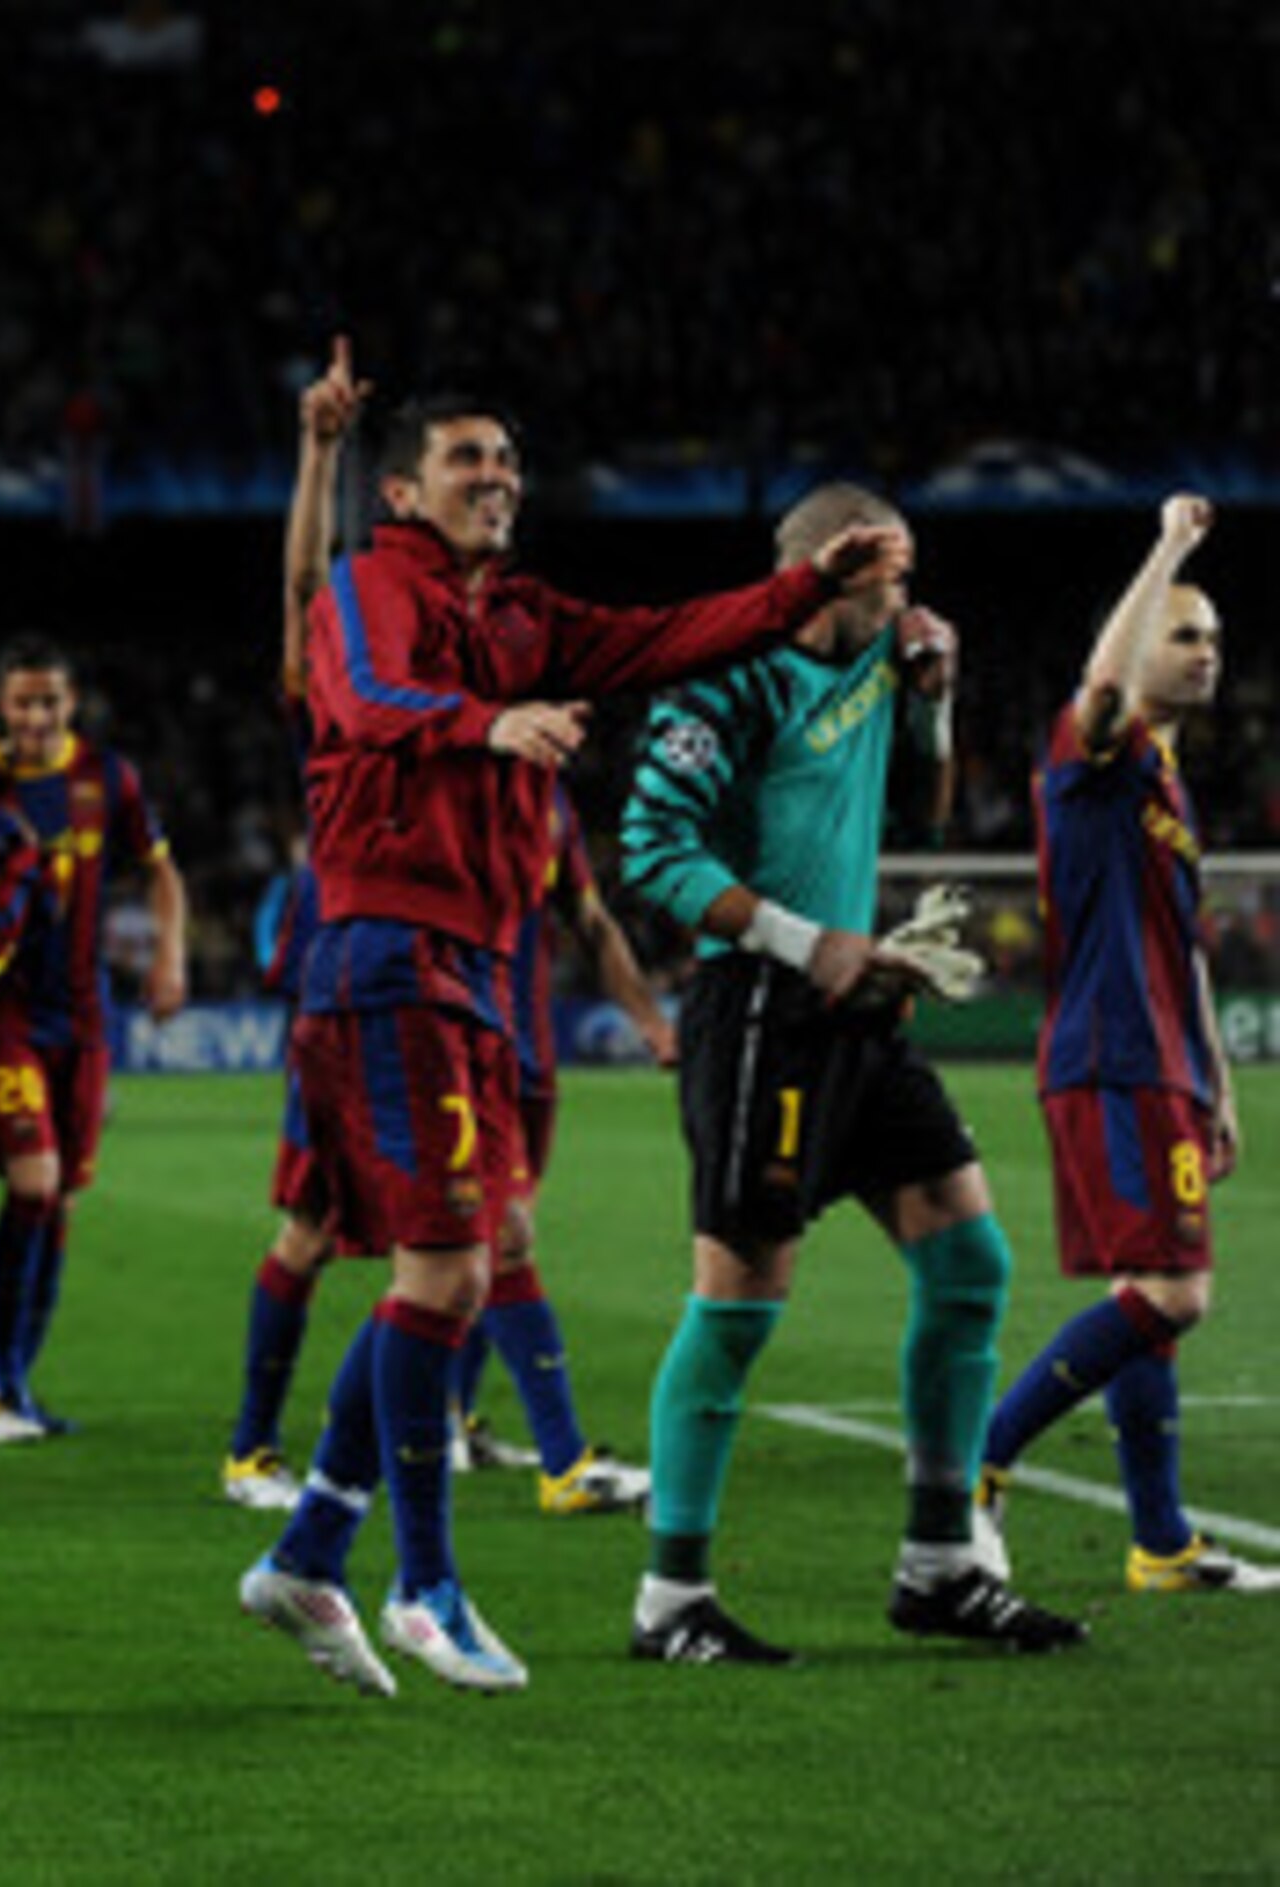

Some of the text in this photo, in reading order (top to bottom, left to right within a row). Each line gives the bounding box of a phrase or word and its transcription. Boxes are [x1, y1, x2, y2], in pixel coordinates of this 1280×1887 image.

[128, 1008, 286, 1071] NEW
[439, 1095, 477, 1171] 7
[778, 1087, 802, 1158] 1
[1169, 1139, 1206, 1207] 8
